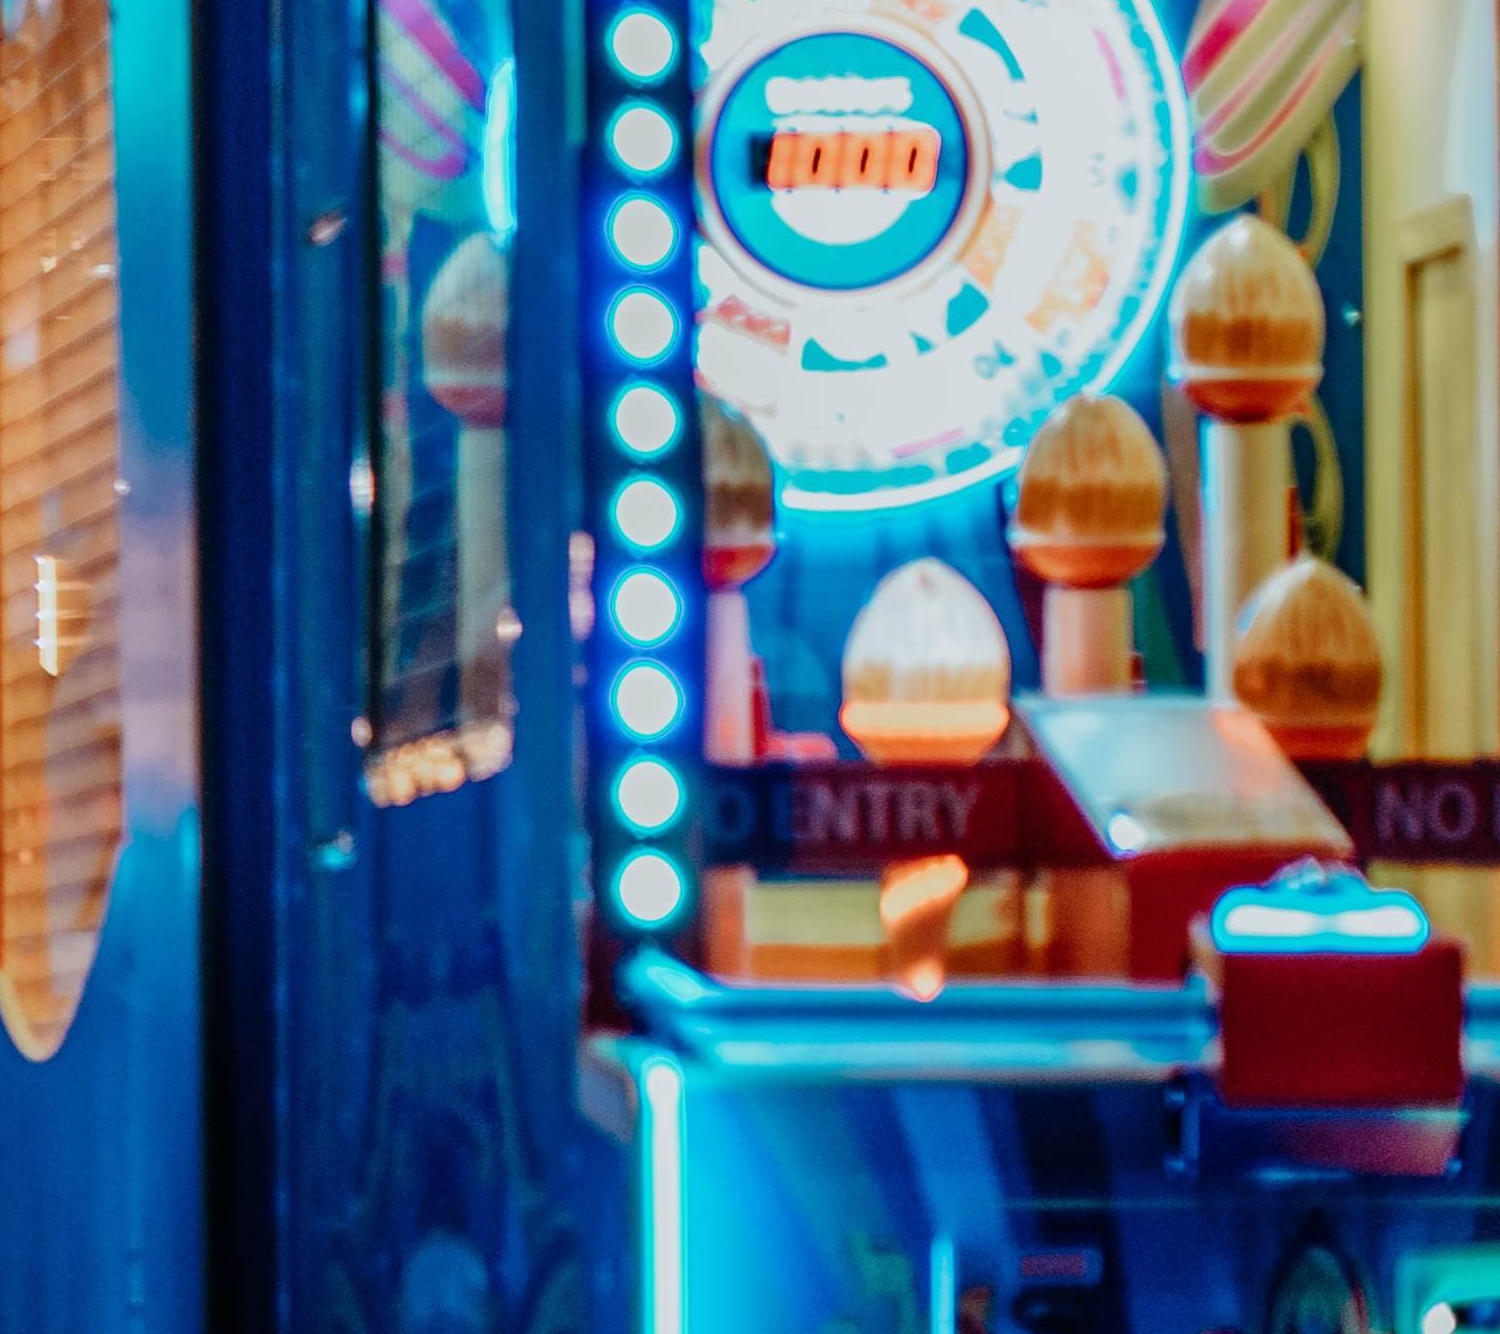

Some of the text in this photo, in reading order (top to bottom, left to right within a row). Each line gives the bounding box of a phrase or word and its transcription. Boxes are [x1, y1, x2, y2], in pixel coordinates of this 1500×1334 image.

[706, 781, 980, 842] O ENTRY
[1377, 780, 1478, 842] NO
